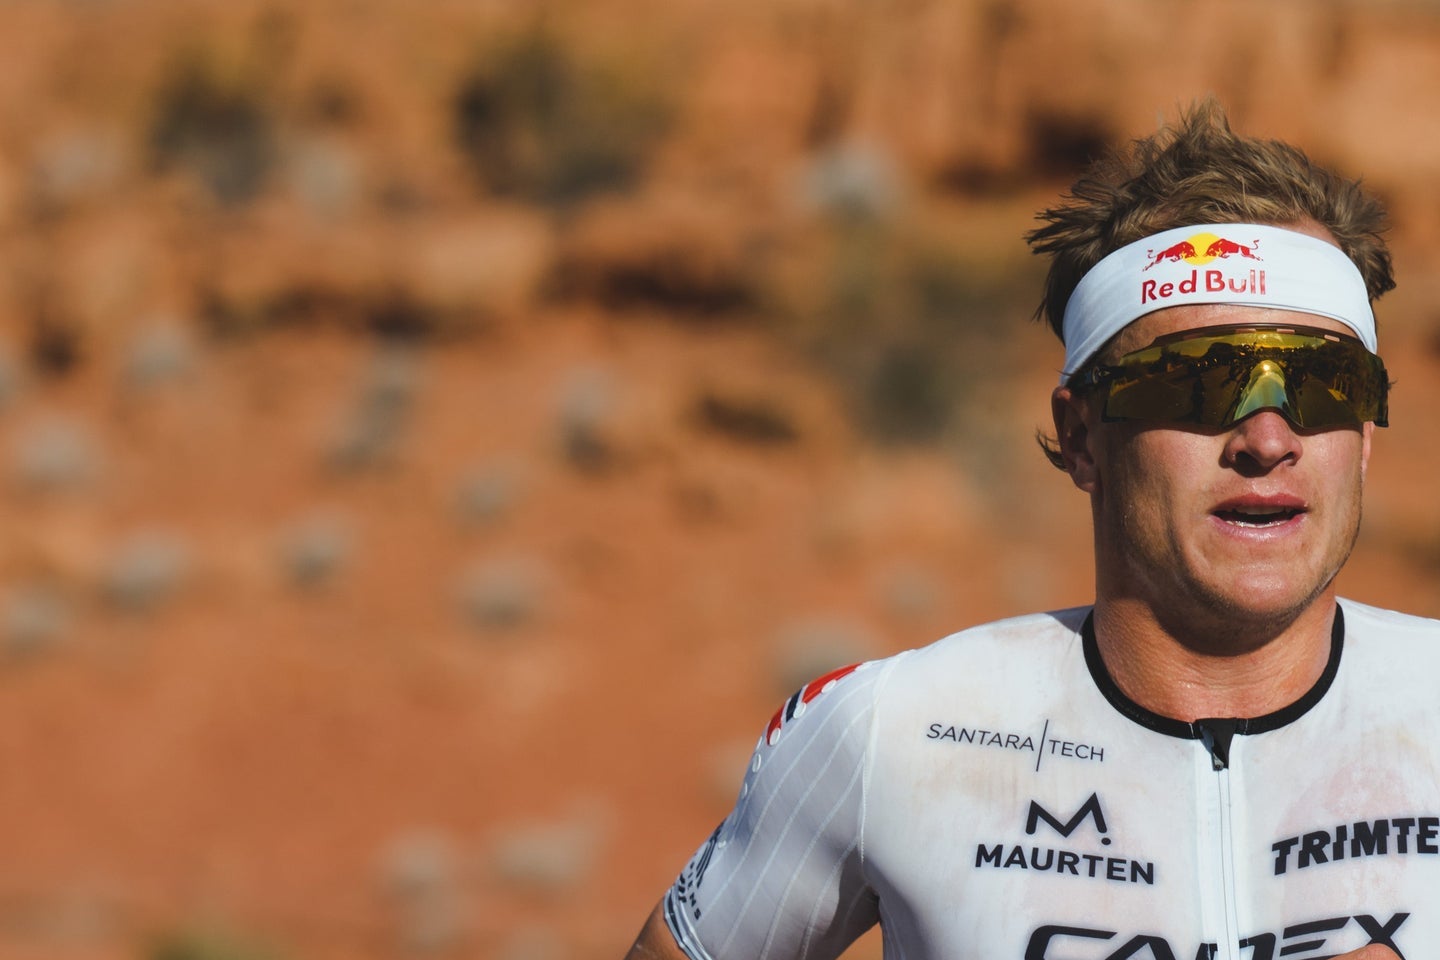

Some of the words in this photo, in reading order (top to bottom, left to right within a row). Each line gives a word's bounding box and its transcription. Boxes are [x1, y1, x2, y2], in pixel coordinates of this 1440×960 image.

[1141, 269, 1196, 305] Red
[1205, 268, 1266, 296] Bull
[926, 723, 1035, 751] SANTARA
[1048, 739, 1104, 762] TECH
[975, 843, 1154, 885] MAURTEN
